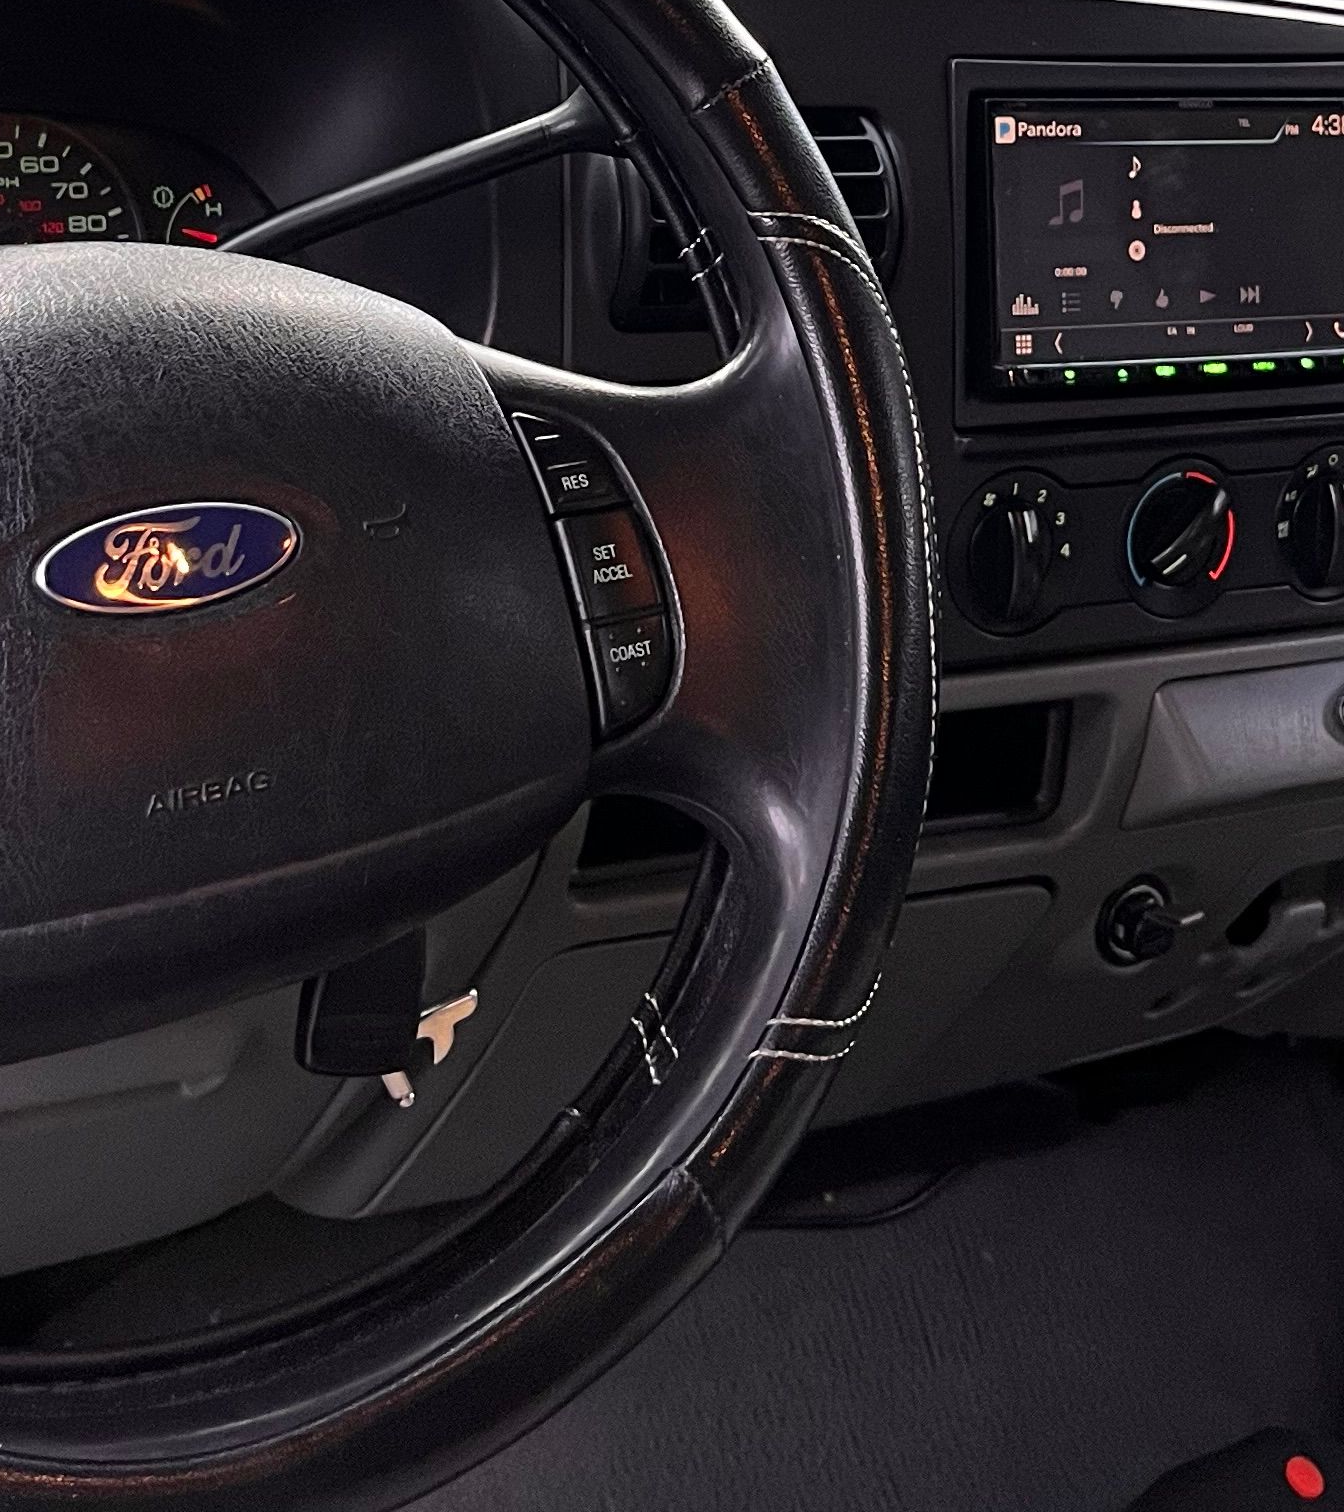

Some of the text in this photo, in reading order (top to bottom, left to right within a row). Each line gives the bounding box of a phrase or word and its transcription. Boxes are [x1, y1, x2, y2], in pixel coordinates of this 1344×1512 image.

[1018, 120, 1082, 138] Pandora
[1285, 123, 1299, 136] PM
[20, 156, 60, 174] 60
[51, 182, 88, 200] 70
[205, 202, 222, 216] H
[68, 215, 107, 233] 80
[561, 474, 589, 490] RES
[1037, 489, 1047, 503] 2
[1055, 512, 1065, 525] 3
[96, 515, 245, 600] Ford
[592, 544, 617, 561] SET
[1060, 543, 1070, 557] 4
[592, 564, 633, 585] ACCEL
[609, 640, 652, 663] COAST
[146, 768, 276, 818] AIRBAG
